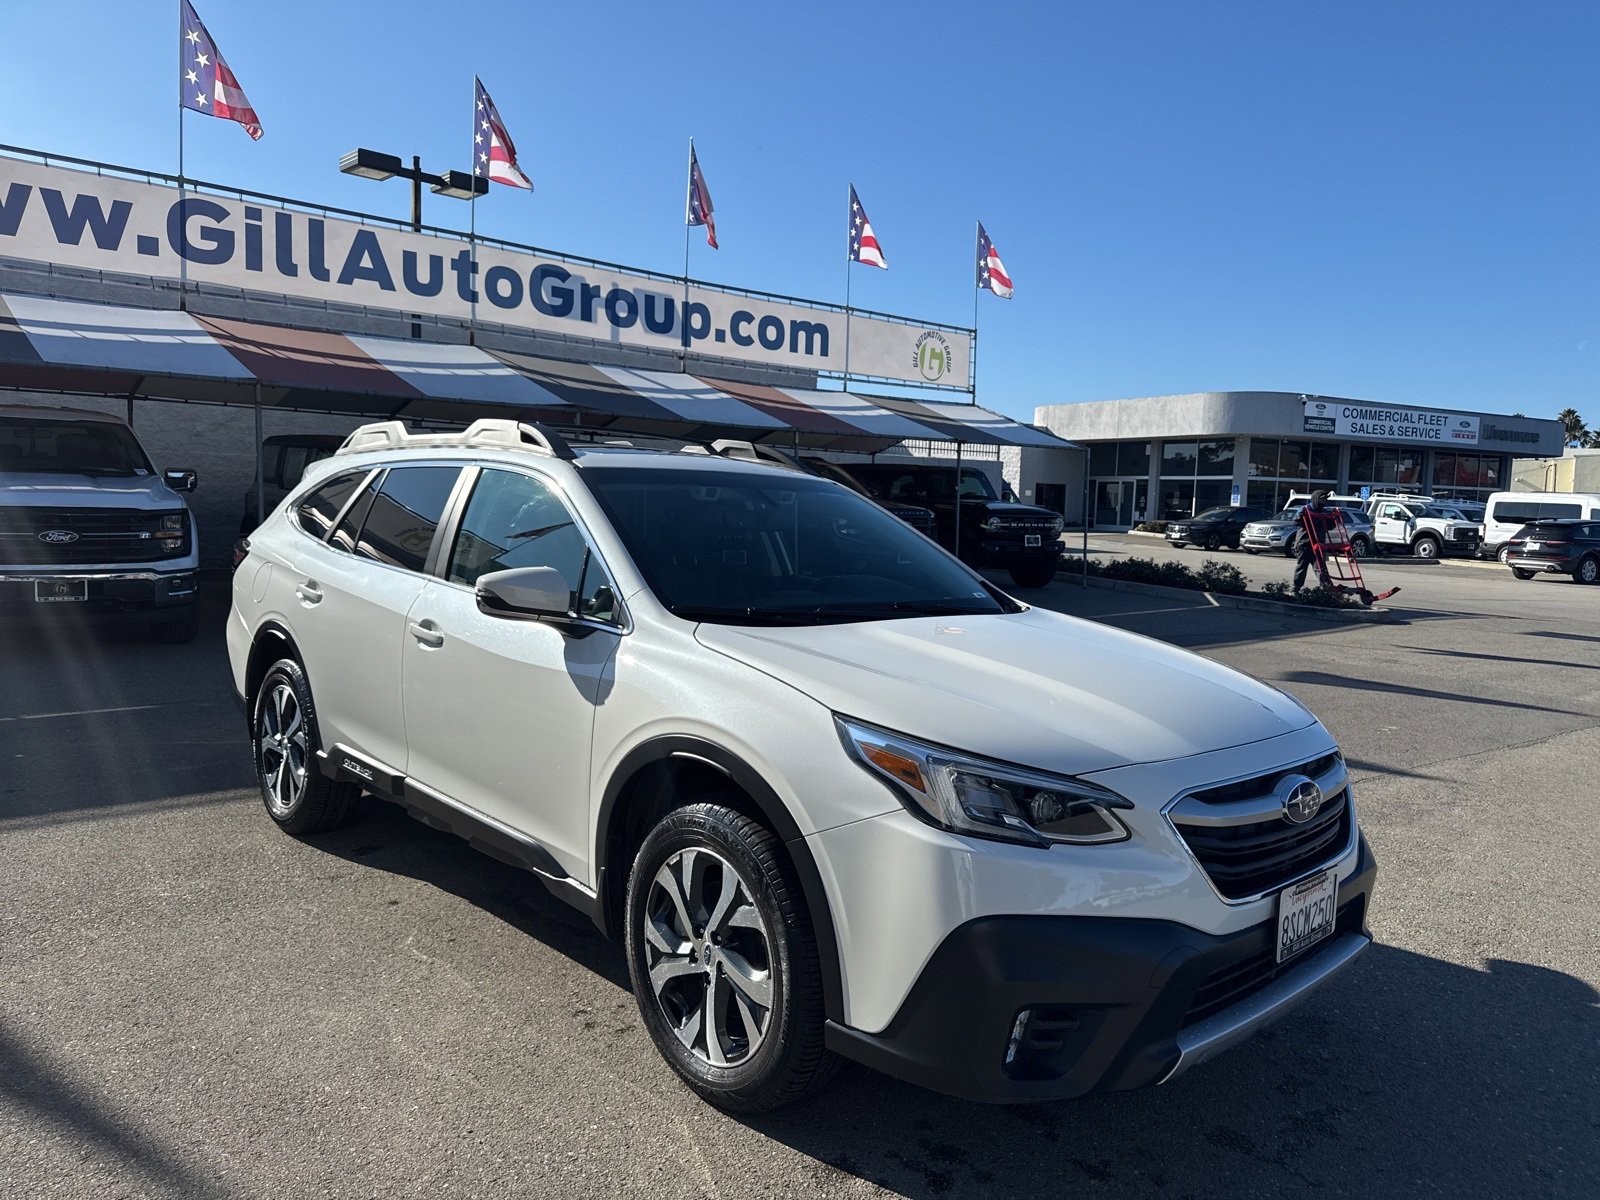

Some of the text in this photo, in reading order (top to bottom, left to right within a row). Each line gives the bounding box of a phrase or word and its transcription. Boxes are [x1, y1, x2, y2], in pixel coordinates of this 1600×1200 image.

[915, 330, 946, 350] AUTOMOTIVE
[943, 345, 951, 373] GROUP
[1342, 407, 1416, 424] COMMERCIAL
[1417, 413, 1449, 427] FLEET
[1350, 422, 1386, 436] SALES
[1388, 425, 1395, 436] &
[1397, 426, 1441, 439] SERVICE
[46, 531, 71, 541] Ford
[343, 758, 373, 777] OUTBACK
[1281, 894, 1333, 948] 8SCM250
